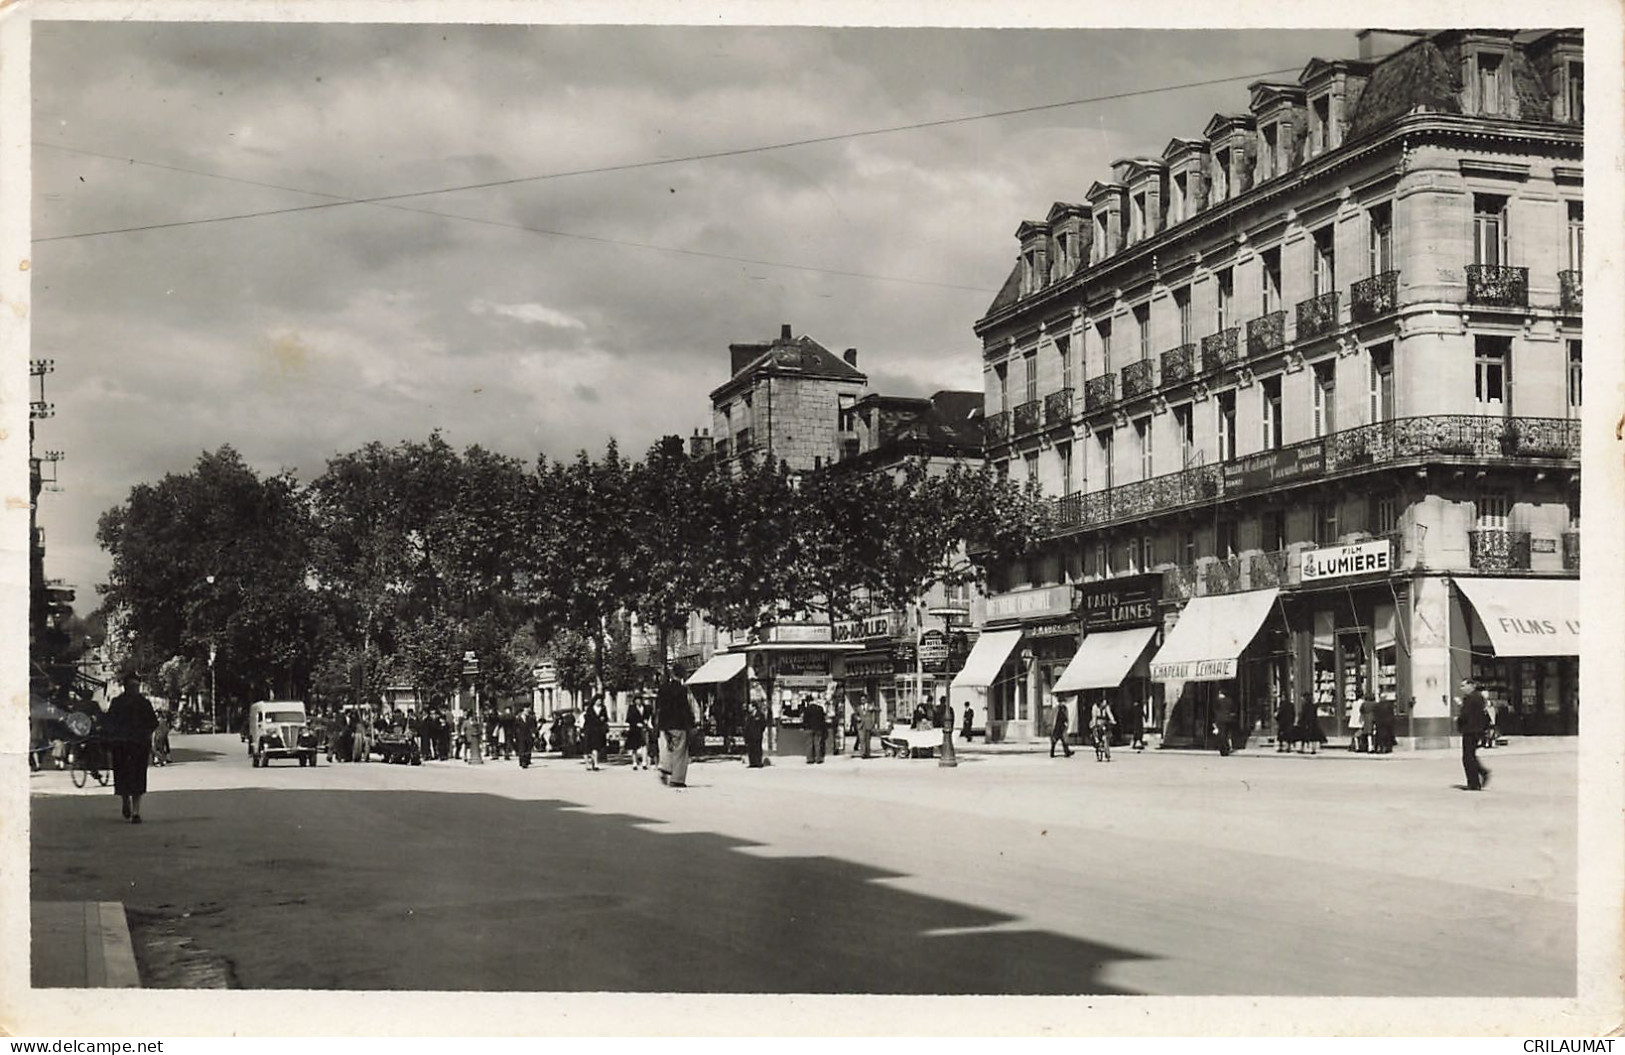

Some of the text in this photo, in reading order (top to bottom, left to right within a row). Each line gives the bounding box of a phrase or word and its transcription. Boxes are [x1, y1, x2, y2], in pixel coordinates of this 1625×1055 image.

[1342, 546, 1362, 555] FILM
[1087, 594, 1118, 609] PARIS
[1111, 604, 1152, 622] LAINES
[1499, 618, 1556, 634] FILMS
